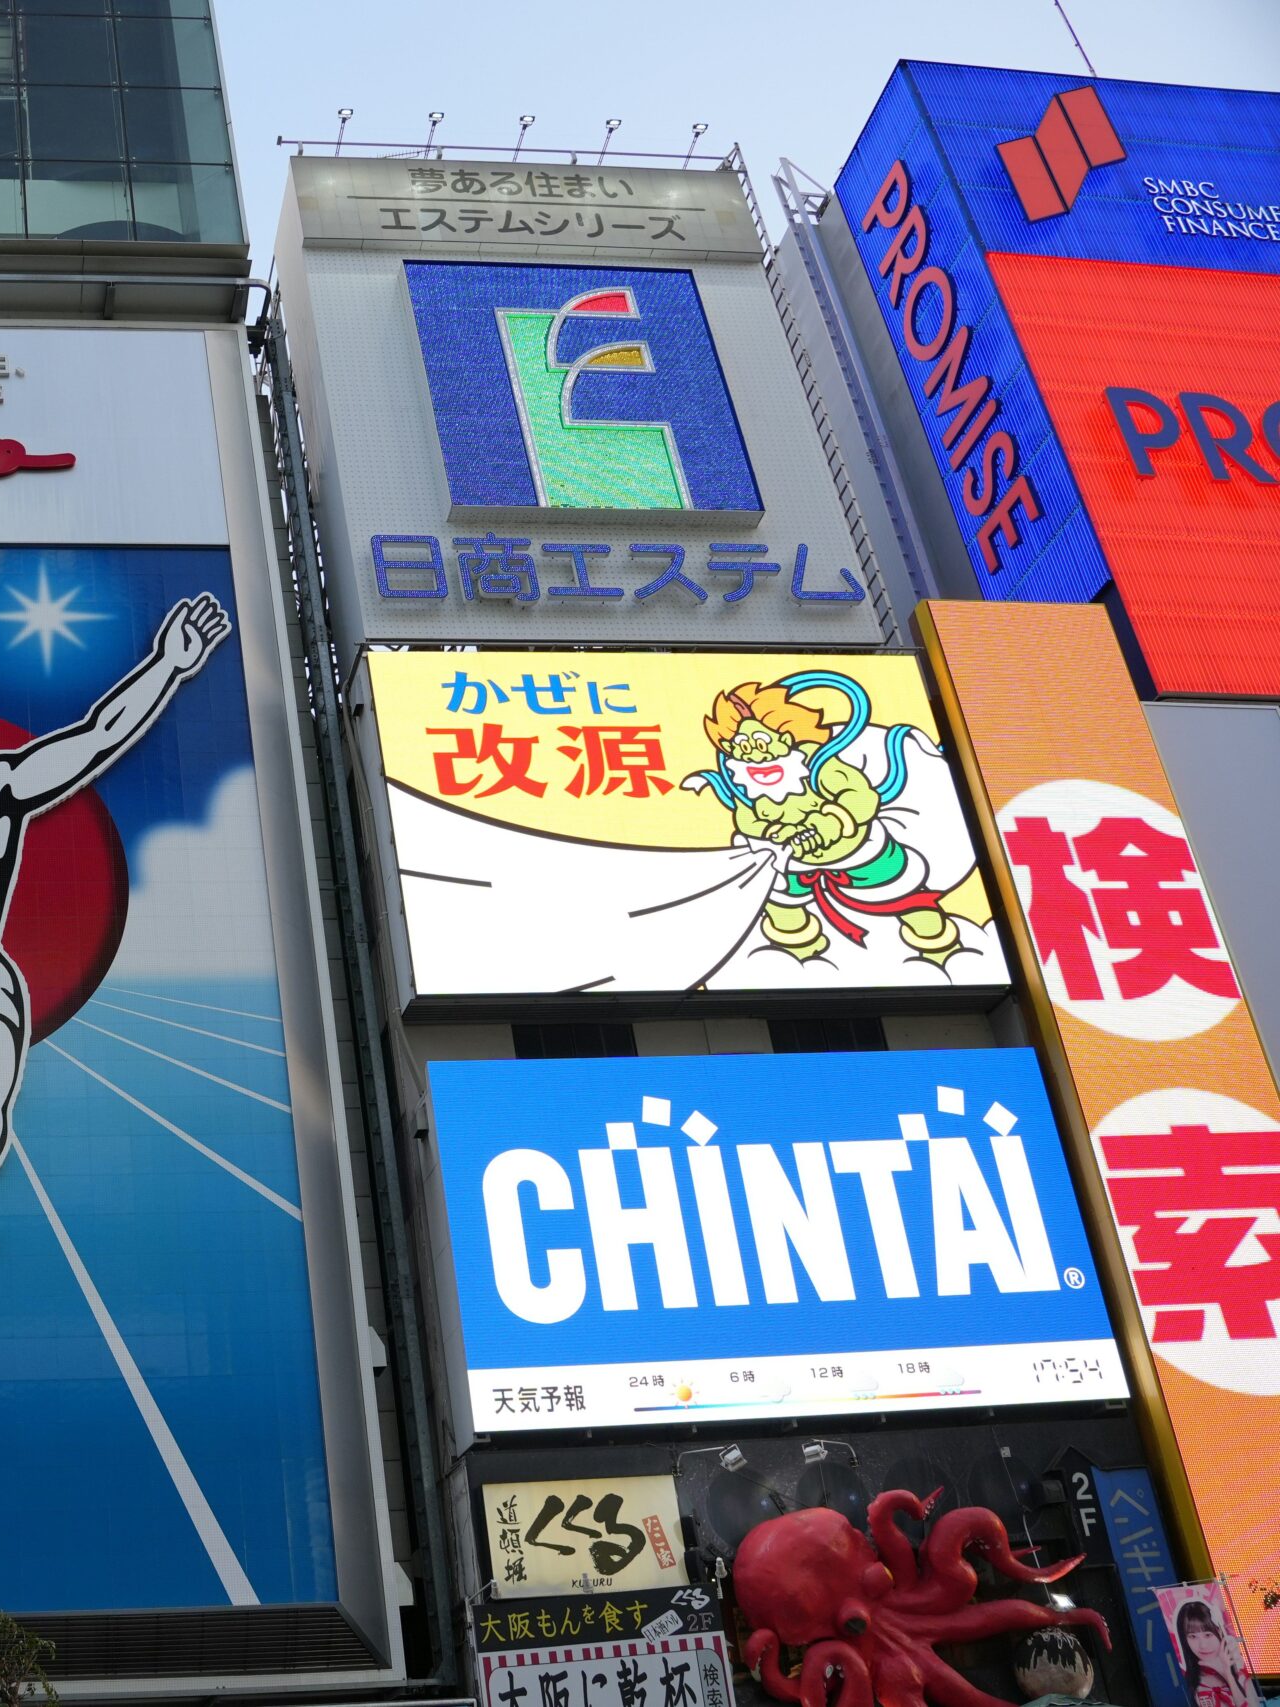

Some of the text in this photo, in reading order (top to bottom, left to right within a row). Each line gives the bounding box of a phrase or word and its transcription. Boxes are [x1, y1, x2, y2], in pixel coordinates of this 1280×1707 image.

[407, 166, 634, 200] 夢ある住まい
[1143, 177, 1219, 199] SMBC
[379, 207, 686, 243] エステムシリーズ
[1161, 215, 1280, 241] FINANCE
[861, 159, 1045, 575] PROMISE
[370, 531, 867, 605] 日商エステム
[440, 669, 638, 715] かぜに
[425, 722, 676, 799] 改源
[1005, 817, 1280, 1343] 検索
[481, 1085, 1062, 1325] CHINTAI
[628, 1374, 665, 1388] 24時
[729, 1369, 756, 1384] 6時
[809, 1365, 844, 1379] 12時
[897, 1361, 931, 1375] 18時
[1032, 1356, 1104, 1384] 17:54
[492, 1384, 586, 1414] 天気予報
[495, 1494, 528, 1585] 道頓堀
[523, 1493, 647, 1576] くくる
[670, 1587, 711, 1610] くくる
[479, 1600, 648, 1644] 大阪もんを食す
[686, 1612, 715, 1632] 2F
